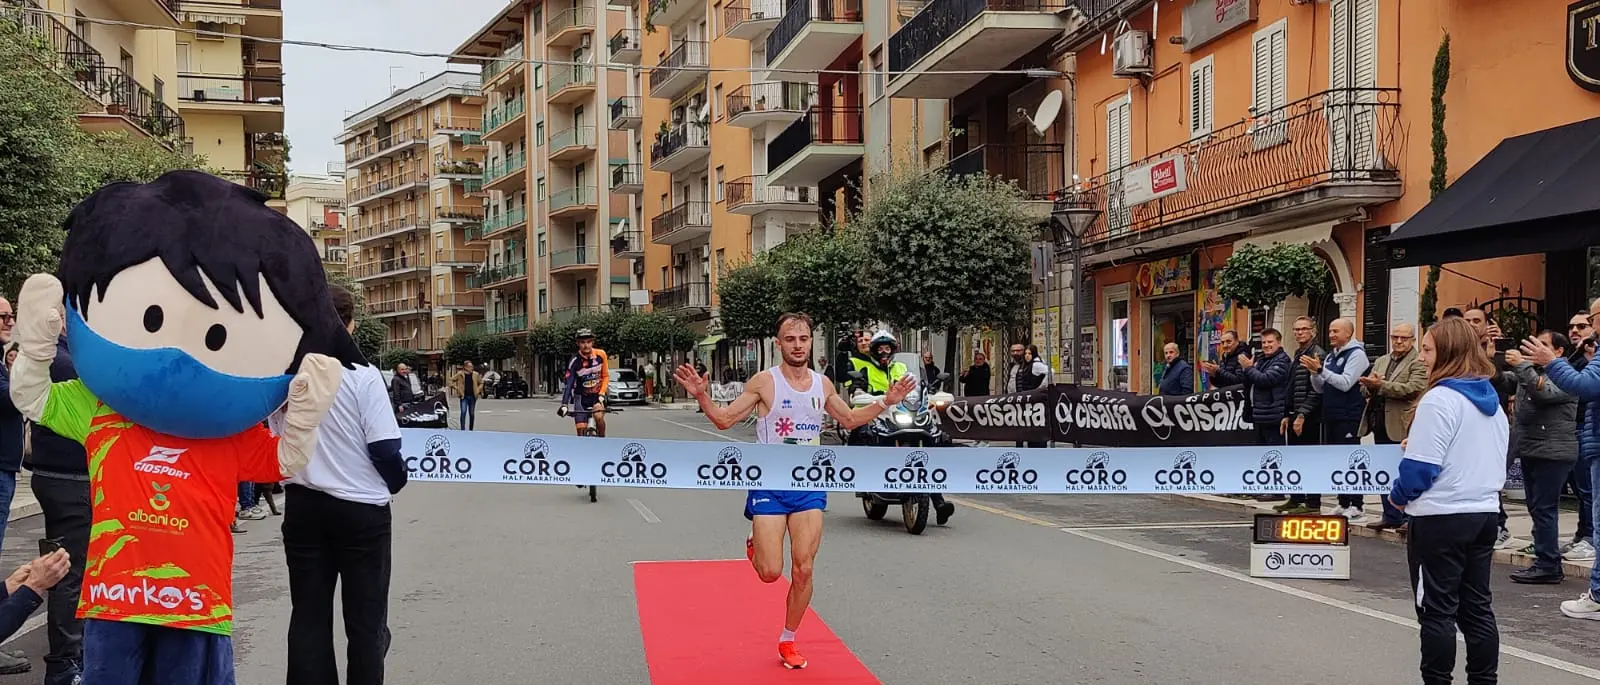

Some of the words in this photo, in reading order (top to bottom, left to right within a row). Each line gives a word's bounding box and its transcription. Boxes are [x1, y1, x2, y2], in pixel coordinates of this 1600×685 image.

[973, 402, 1045, 427] cisalfa
[1075, 403, 1138, 430] cisalfa
[133, 461, 191, 480] GIOSPORT
[405, 456, 472, 473] CORO
[503, 458, 571, 476] CORO
[601, 461, 667, 479] CORO
[697, 464, 762, 481] CORO
[791, 466, 856, 483] CORO
[884, 467, 948, 484] CORO
[976, 469, 1038, 485] CORO
[1066, 469, 1127, 485] CORO
[1154, 469, 1215, 486] CORO
[1242, 469, 1302, 486] CORO
[1330, 470, 1390, 486] CORO
[128, 509, 169, 526] albani
[169, 516, 189, 530] op
